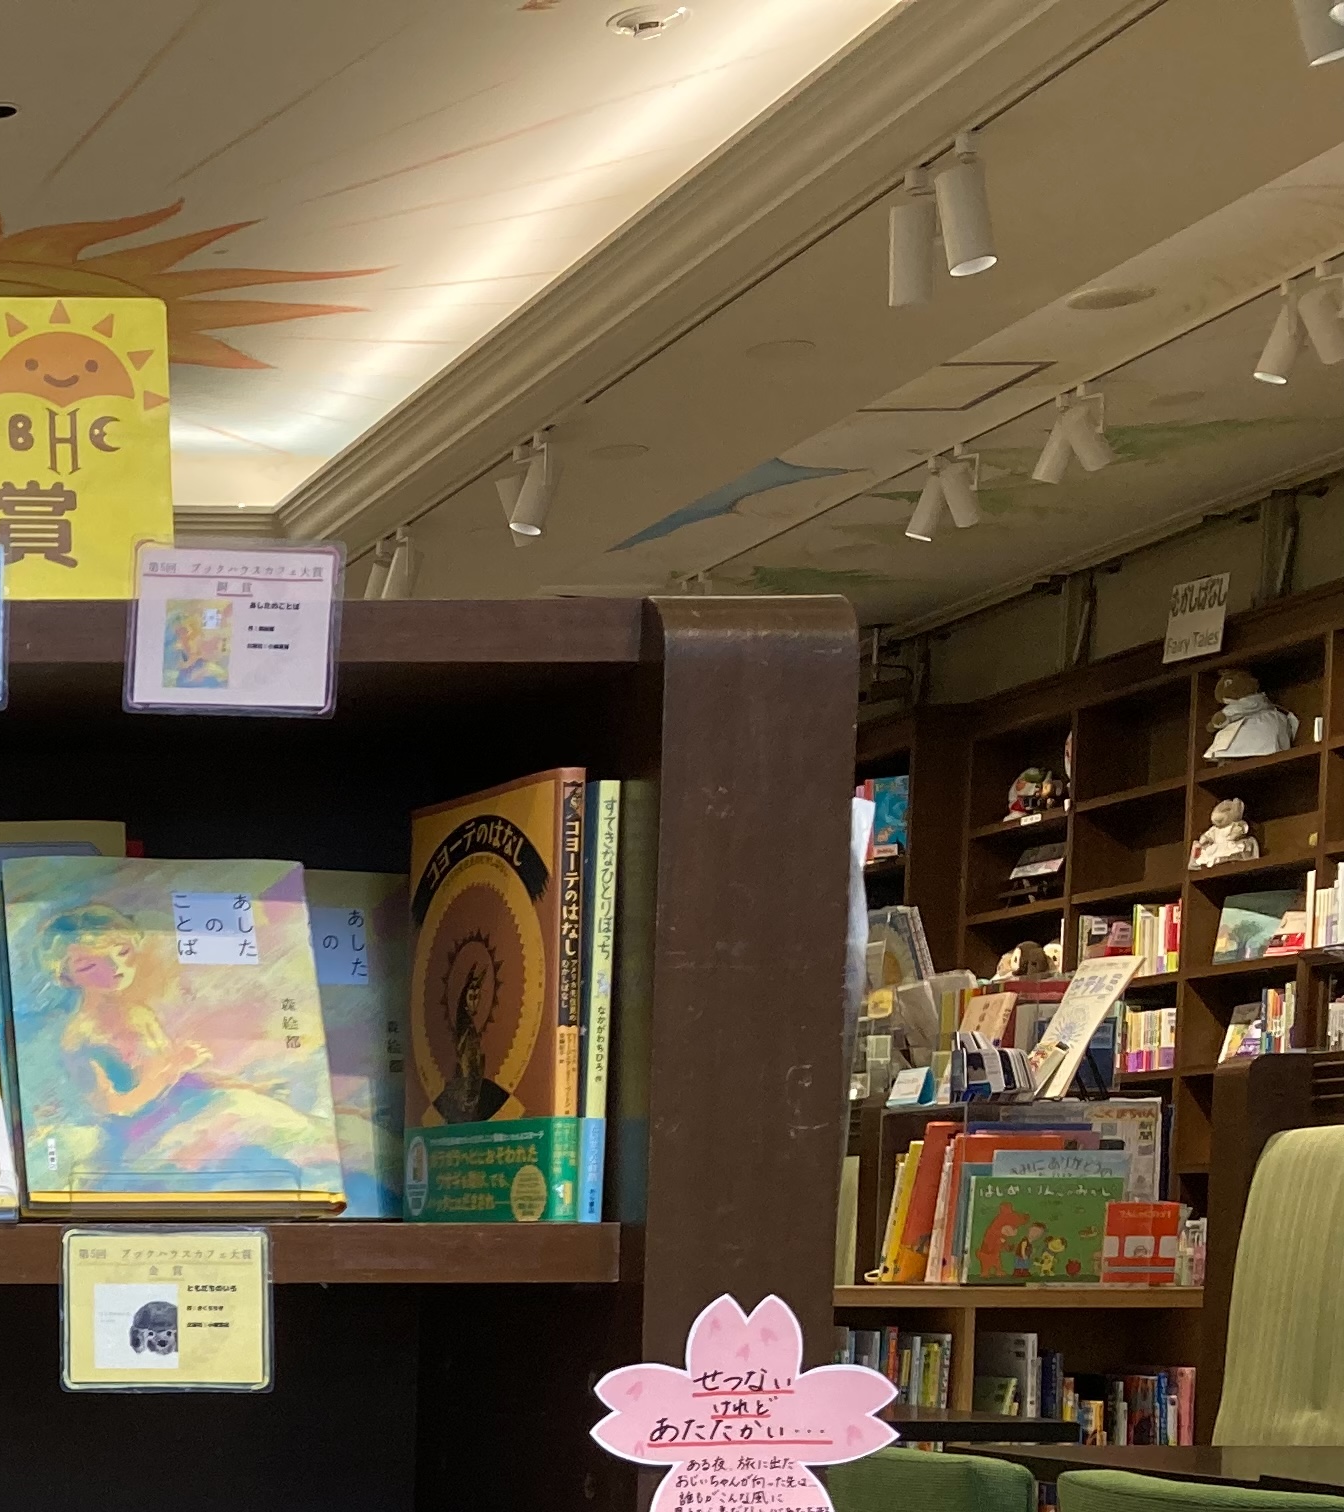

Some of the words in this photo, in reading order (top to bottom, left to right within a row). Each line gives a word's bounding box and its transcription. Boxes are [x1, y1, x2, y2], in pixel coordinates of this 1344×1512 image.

[426, 820, 524, 889] コヨーテのはなし
[562, 820, 582, 956] コヨーテのはなし
[79, 1249, 107, 1260] 第5回
[122, 1249, 252, 1260] ブックハウスカフェ大賞
[693, 1368, 792, 1392] せつない
